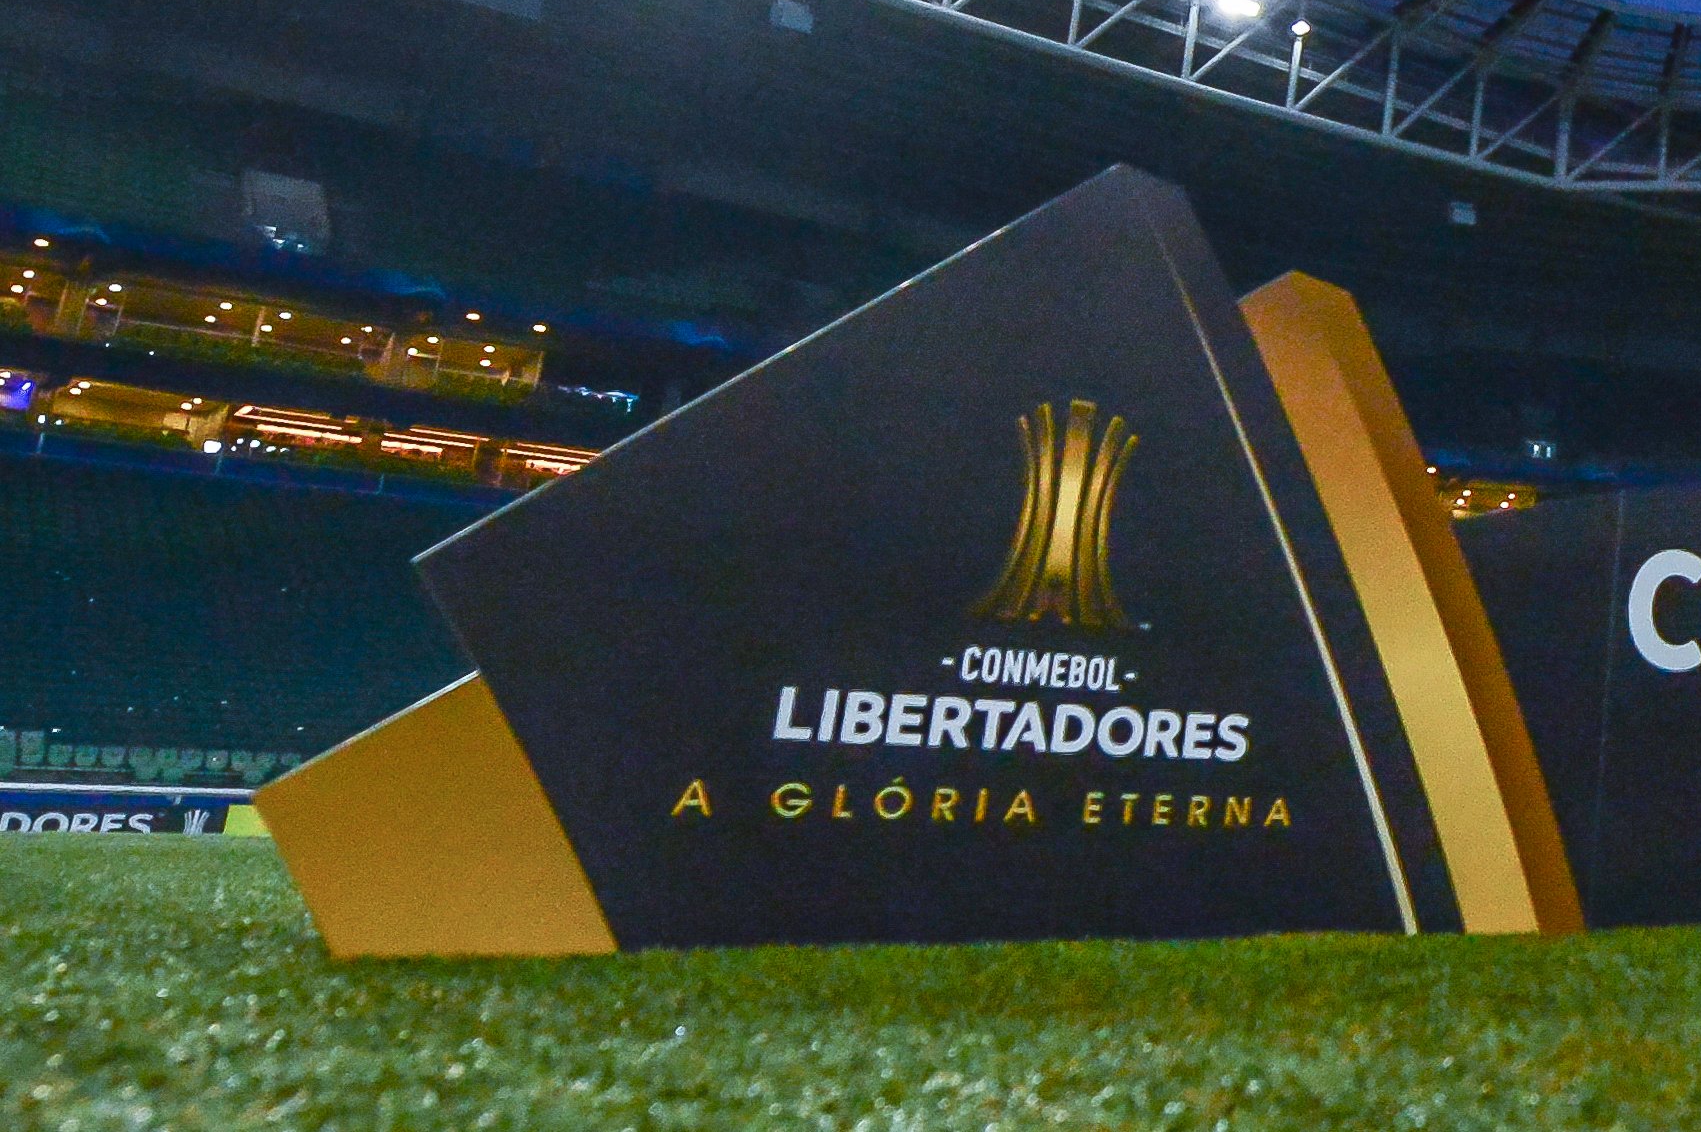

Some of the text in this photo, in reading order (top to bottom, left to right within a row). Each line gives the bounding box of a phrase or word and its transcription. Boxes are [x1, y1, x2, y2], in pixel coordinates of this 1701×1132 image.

[773, 686, 1249, 761] LIBERTADORES
[671, 776, 1292, 827] A GLÓRIA ETERNA
